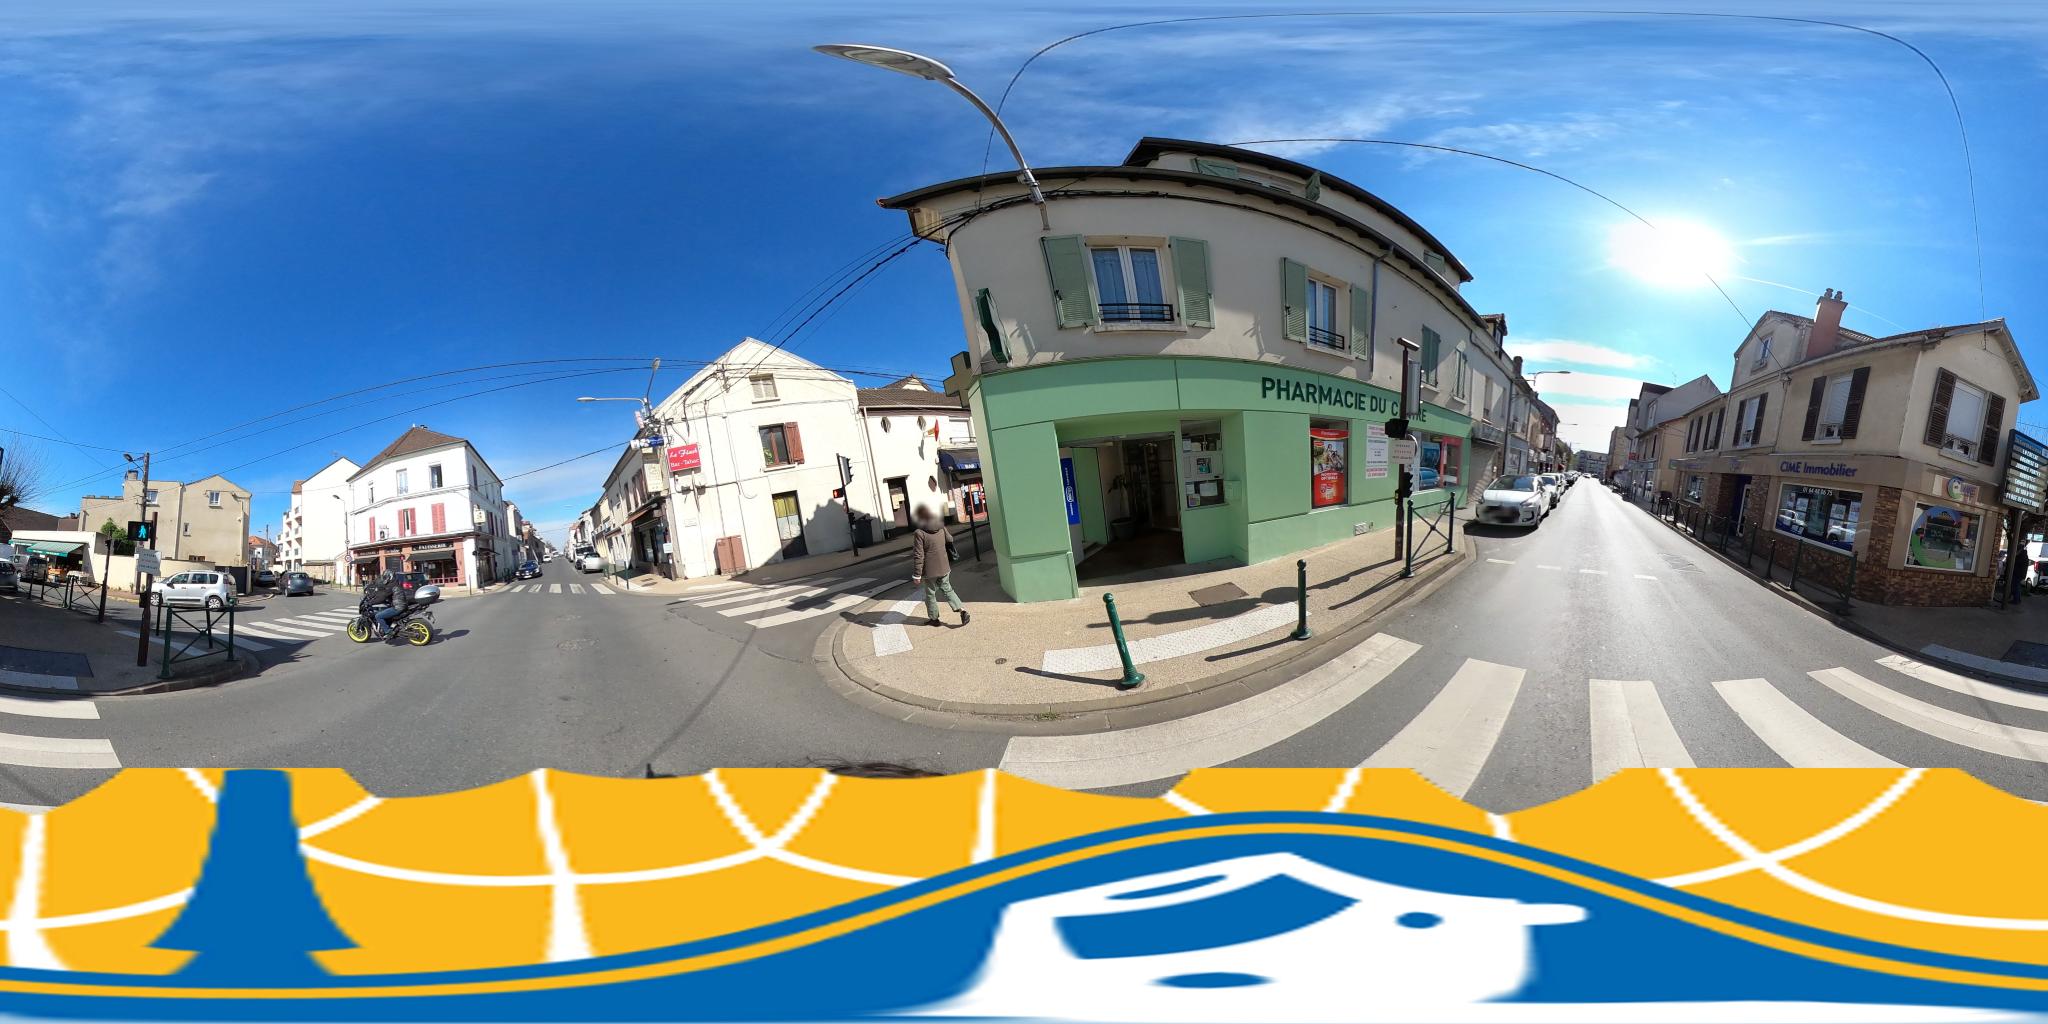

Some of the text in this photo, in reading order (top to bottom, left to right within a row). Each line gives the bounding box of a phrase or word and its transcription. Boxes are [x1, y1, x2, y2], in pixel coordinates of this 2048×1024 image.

[1261, 377, 1366, 411] PHARMACIE
[1370, 395, 1387, 414] DU
[1780, 461, 1858, 477] CIME Immobilier
